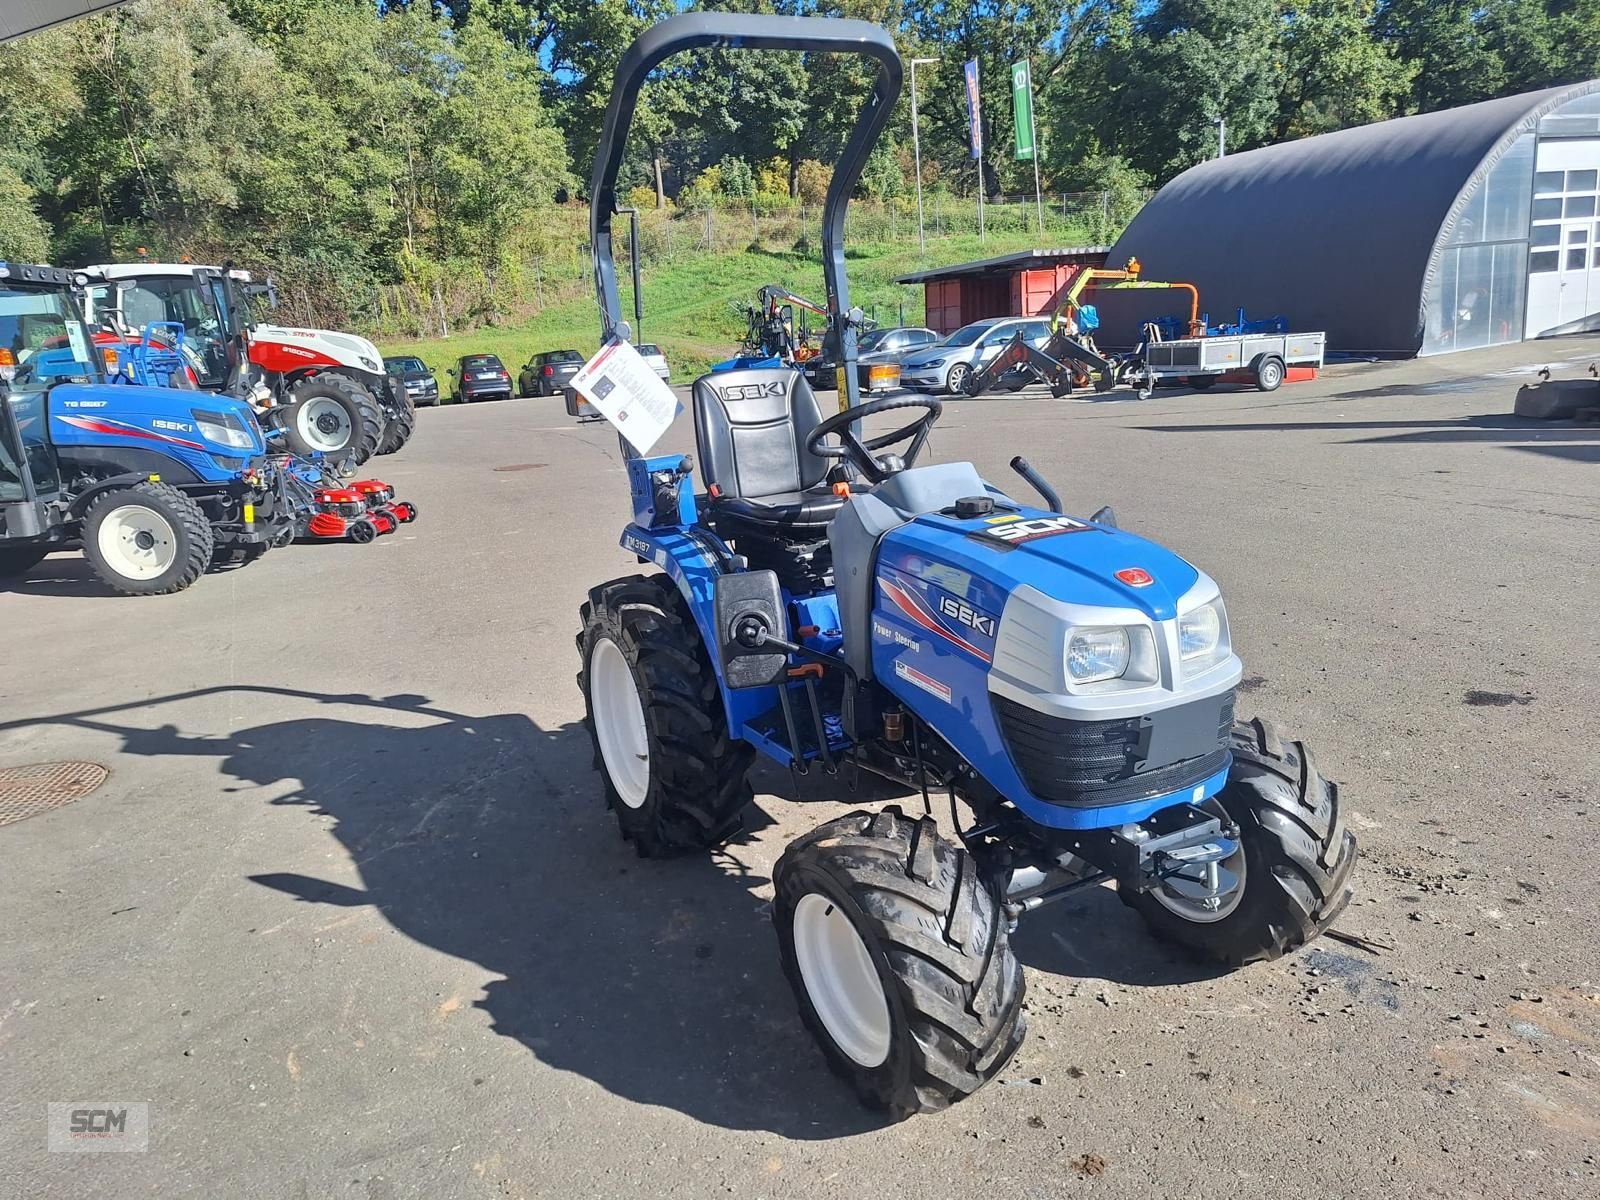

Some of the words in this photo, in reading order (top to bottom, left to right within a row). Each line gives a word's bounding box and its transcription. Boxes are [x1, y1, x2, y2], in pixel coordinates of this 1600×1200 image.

[720, 382, 786, 401] ISEKI
[153, 419, 192, 432] ISEKI
[987, 517, 1087, 540] SCM
[940, 596, 994, 636] ISEKI
[873, 621, 892, 638] Power
[895, 631, 920, 652] Steering
